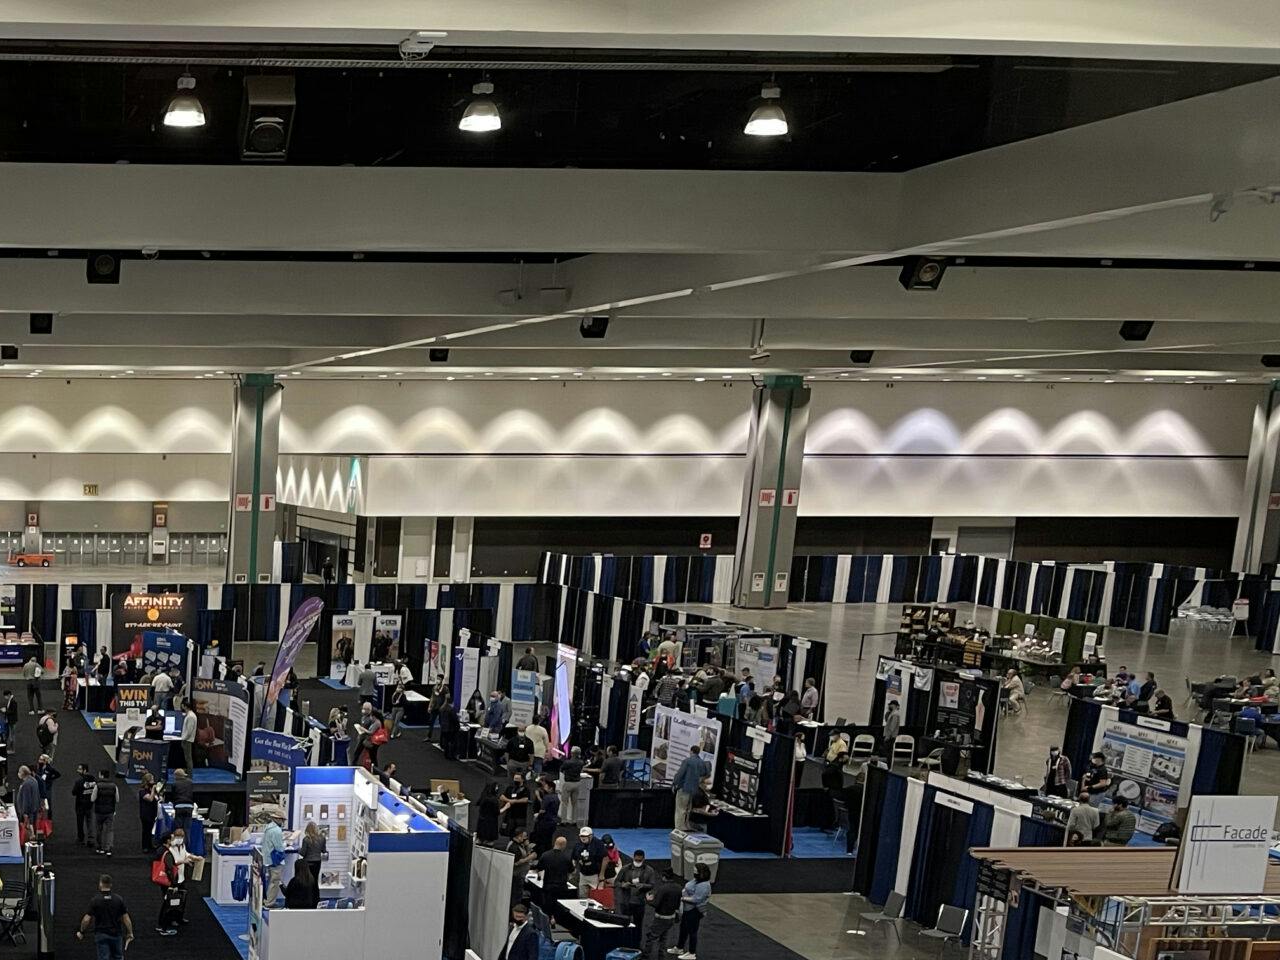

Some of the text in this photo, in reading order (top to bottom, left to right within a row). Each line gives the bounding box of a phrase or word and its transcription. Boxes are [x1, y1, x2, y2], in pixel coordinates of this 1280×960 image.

[83, 484, 99, 496] EXIT
[124, 596, 184, 606] AFFINITY
[120, 689, 148, 700] WIN
[627, 703, 638, 731] DELTA
[1224, 824, 1268, 840] Facade
